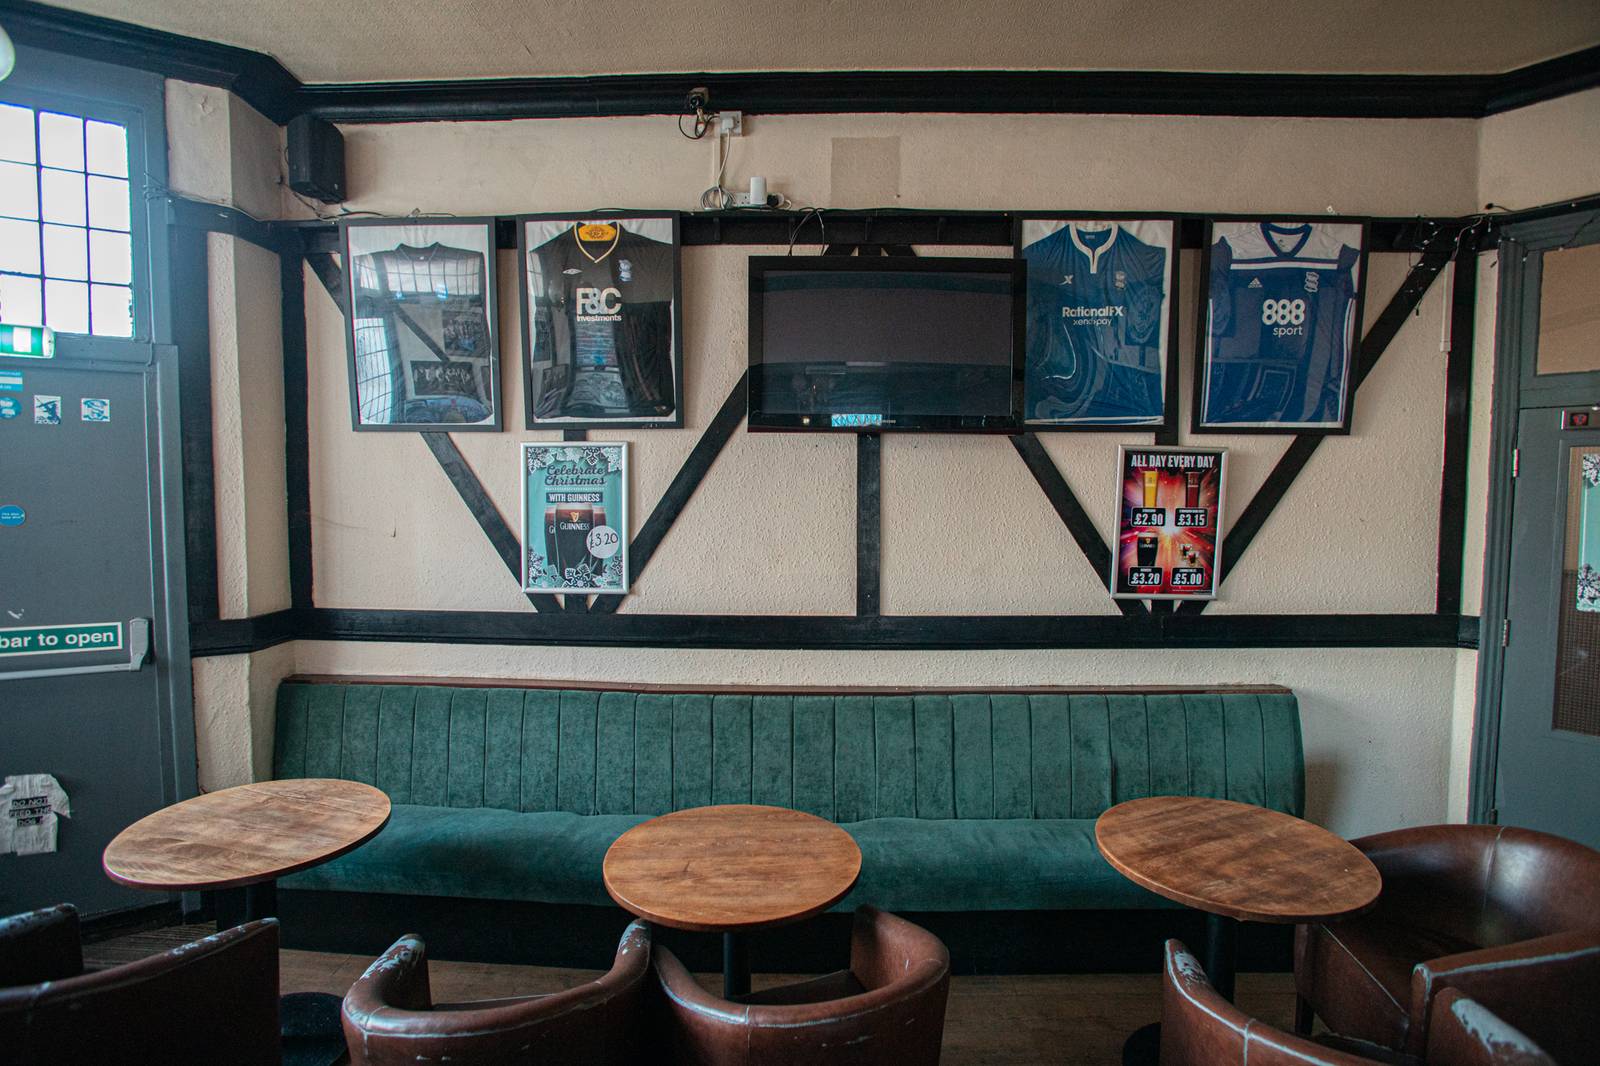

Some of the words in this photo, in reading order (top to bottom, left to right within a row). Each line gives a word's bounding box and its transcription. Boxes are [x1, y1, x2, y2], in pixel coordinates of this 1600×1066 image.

[576, 287, 622, 315] F&C
[1062, 306, 1125, 317] RationalFX
[1262, 299, 1306, 326] 888
[1273, 326, 1303, 338] sport
[1131, 454, 1148, 467] ALL
[1149, 454, 1167, 468] DAY
[1167, 455, 1196, 468] EVERY
[1197, 455, 1215, 468] DAY
[546, 464, 605, 475] Celebrate
[545, 475, 606, 485] Christmas
[549, 493, 566, 502] WITH
[567, 493, 600, 502] GUINNESS
[1133, 513, 1164, 526] £2.90
[1177, 514, 1205, 526] £3.15
[1131, 572, 1160, 585] £3.20
[1173, 573, 1202, 585] £5.00
[0, 634, 32, 649] bar
[38, 633, 59, 646] to
[65, 631, 115, 647] open
